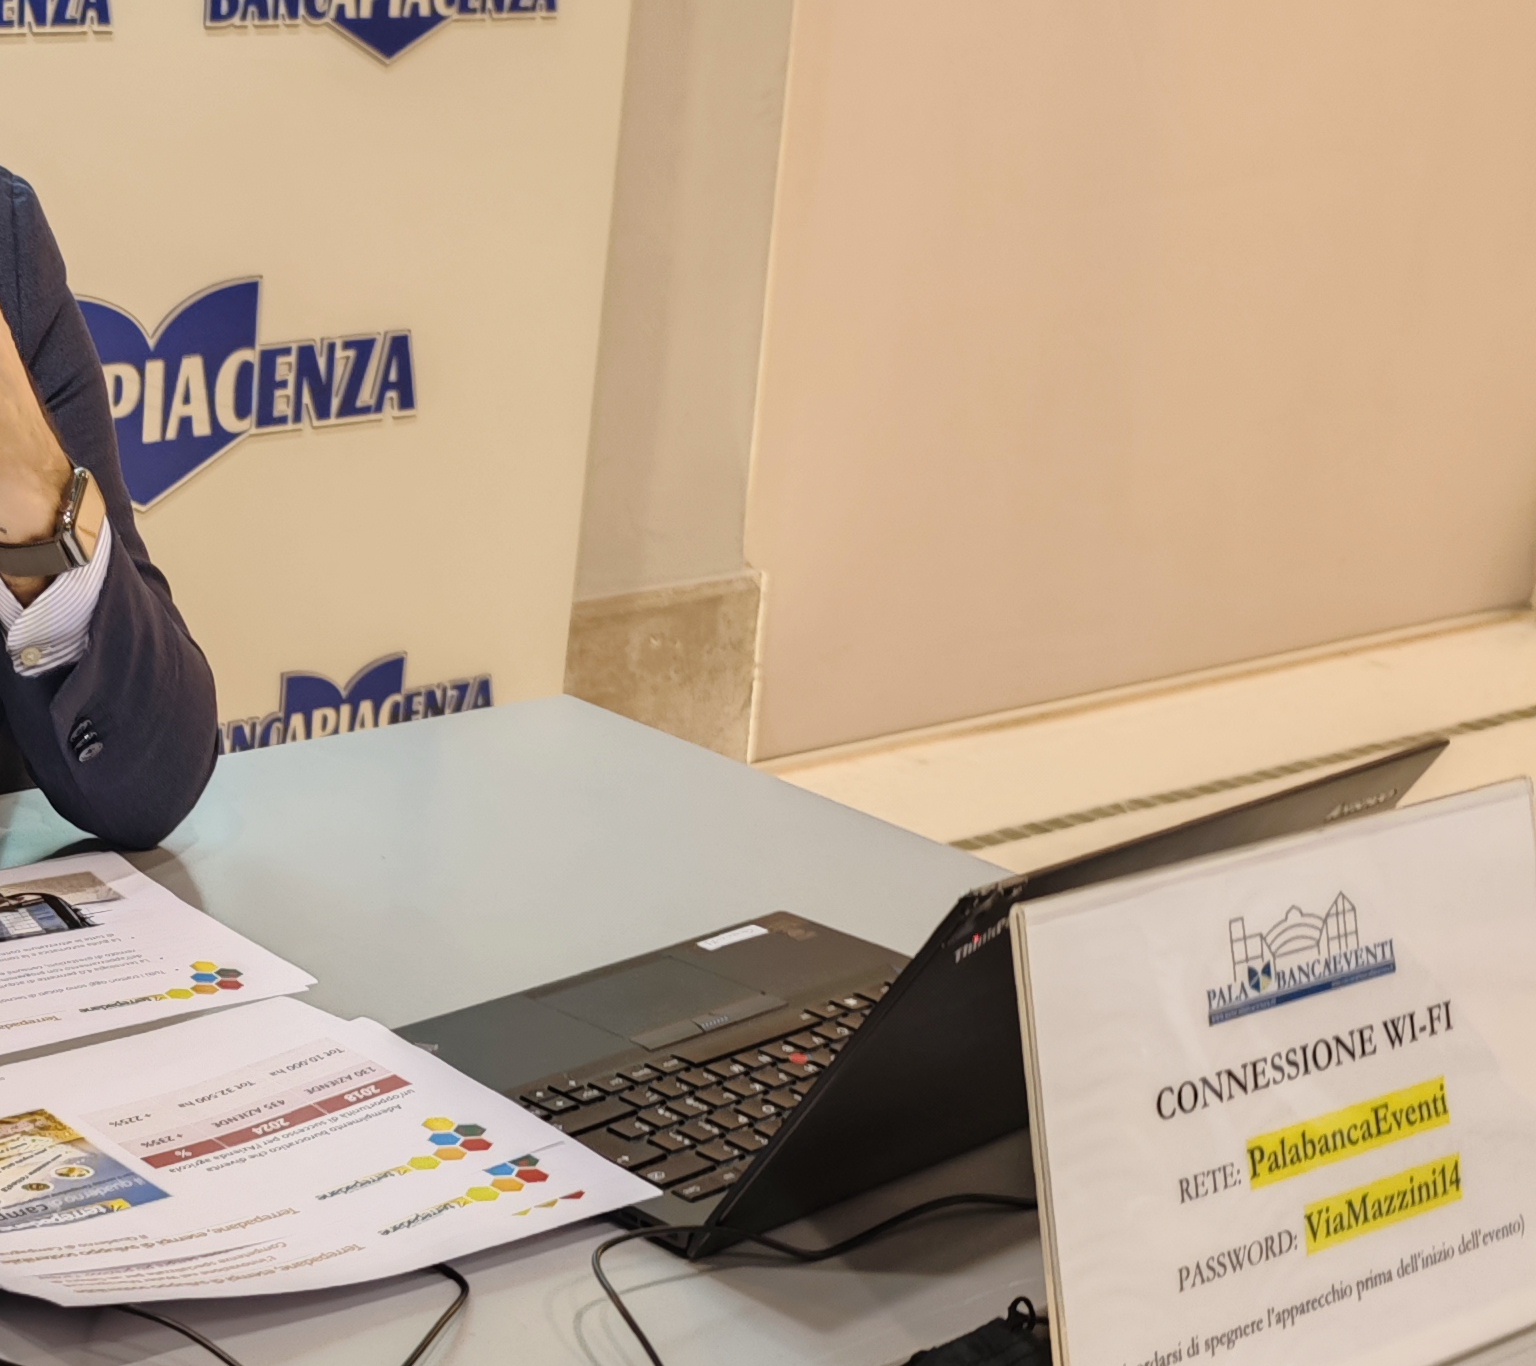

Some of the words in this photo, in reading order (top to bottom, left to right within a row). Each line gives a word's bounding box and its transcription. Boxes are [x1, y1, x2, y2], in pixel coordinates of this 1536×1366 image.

[1206, 979, 1250, 1011] PALA
[1275, 937, 1395, 991] BANCAEVENTI
[343, 1084, 381, 1104] 2018
[1155, 1023, 1378, 1122] CONNESSIONE
[1381, 999, 1455, 1052] WI-FI
[251, 1117, 291, 1137] 2024
[1177, 1161, 1244, 1205] RETE:
[1246, 1083, 1450, 1182] PalabancaEventi
[1176, 1227, 1300, 1294] PASSWORD:
[1304, 1159, 1463, 1246] ViaMazzini14
[1186, 1333, 1201, 1358] di
[1204, 1314, 1265, 1357] spegnere
[1266, 1279, 1353, 1331] l'apparecchio
[1355, 1267, 1394, 1303] prima
[1395, 1243, 1456, 1282] dell'inizio
[1456, 1212, 1527, 1258] dell'evento)
